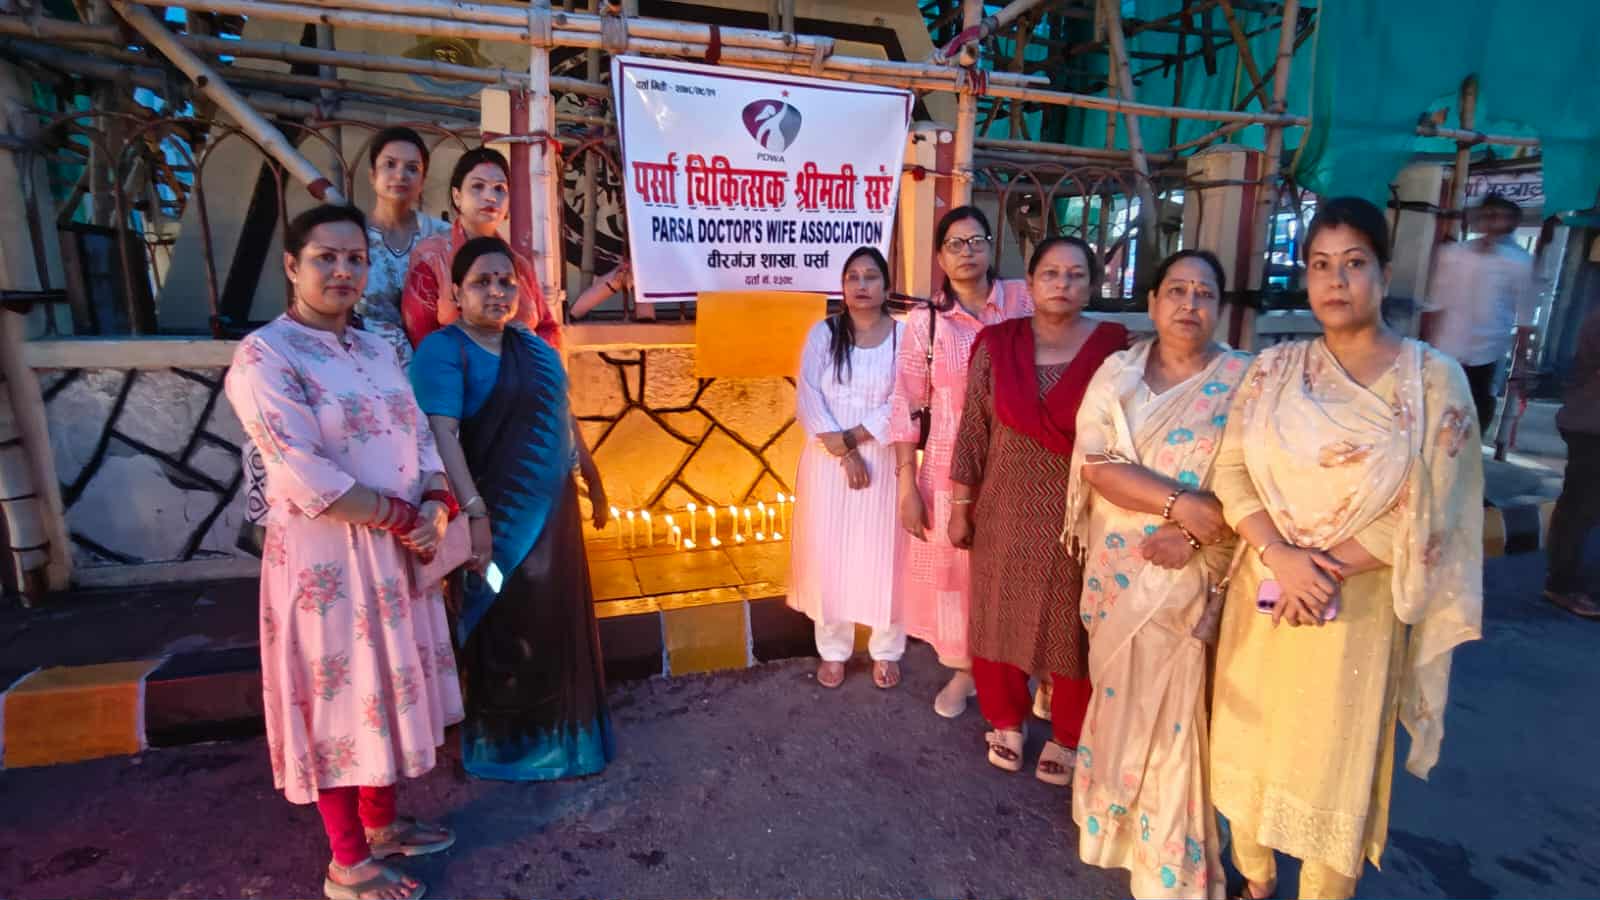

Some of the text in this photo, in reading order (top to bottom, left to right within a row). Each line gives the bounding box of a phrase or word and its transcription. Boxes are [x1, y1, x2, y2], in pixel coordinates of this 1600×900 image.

[756, 152, 785, 162] PDWA
[632, 152, 679, 205] पर्सा
[685, 154, 788, 208] चिकित्सक
[795, 161, 858, 211] श्रीमती
[652, 216, 884, 245] PARSA DOCTOR'S WIFE ASSOCIATION
[707, 249, 757, 269] वीरगंज
[803, 249, 831, 269] पर्सा
